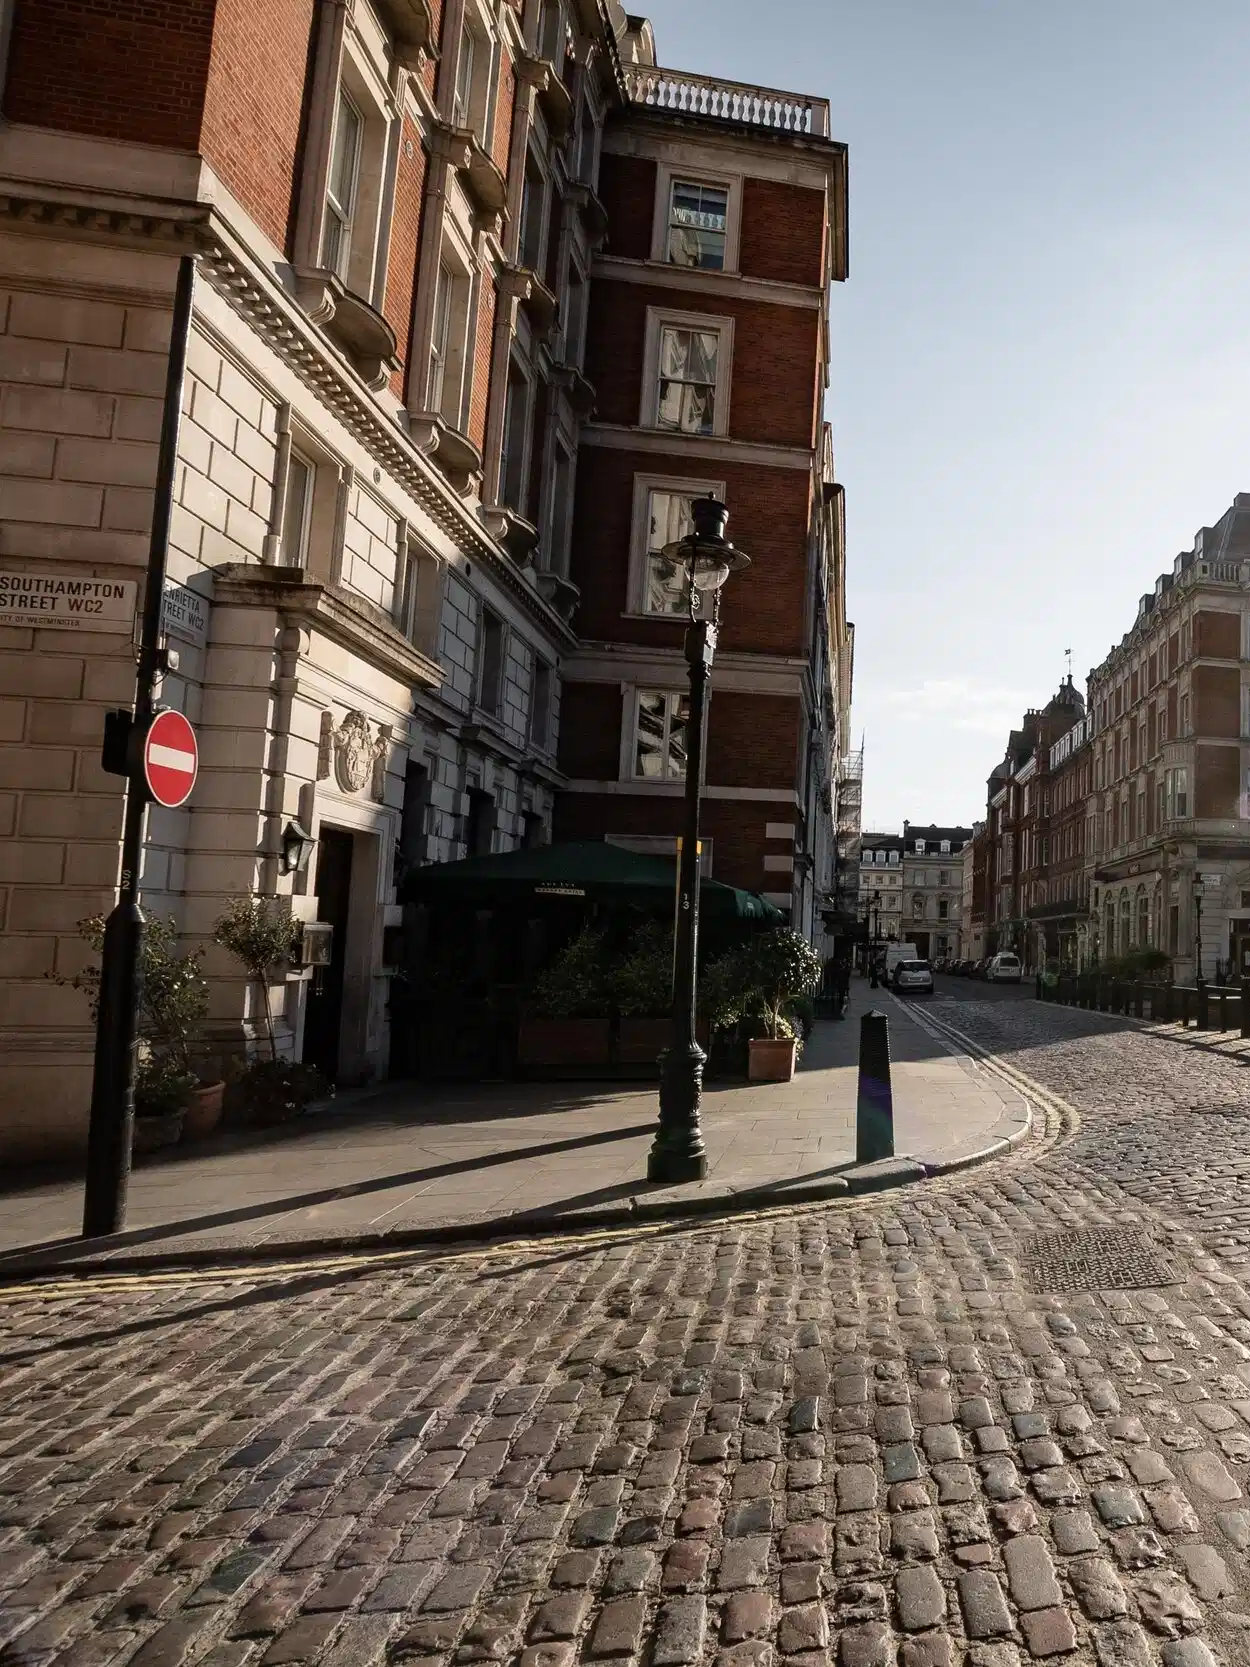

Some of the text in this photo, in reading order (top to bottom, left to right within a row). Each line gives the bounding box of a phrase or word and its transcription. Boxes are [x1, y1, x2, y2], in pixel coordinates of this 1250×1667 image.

[0, 576, 125, 599] SOUTHAMPTON
[0, 593, 104, 614] STREET WC2
[162, 588, 200, 613] ENRIETTA
[163, 599, 186, 621] TREET
[27, 616, 81, 627] WESTMINSTER
